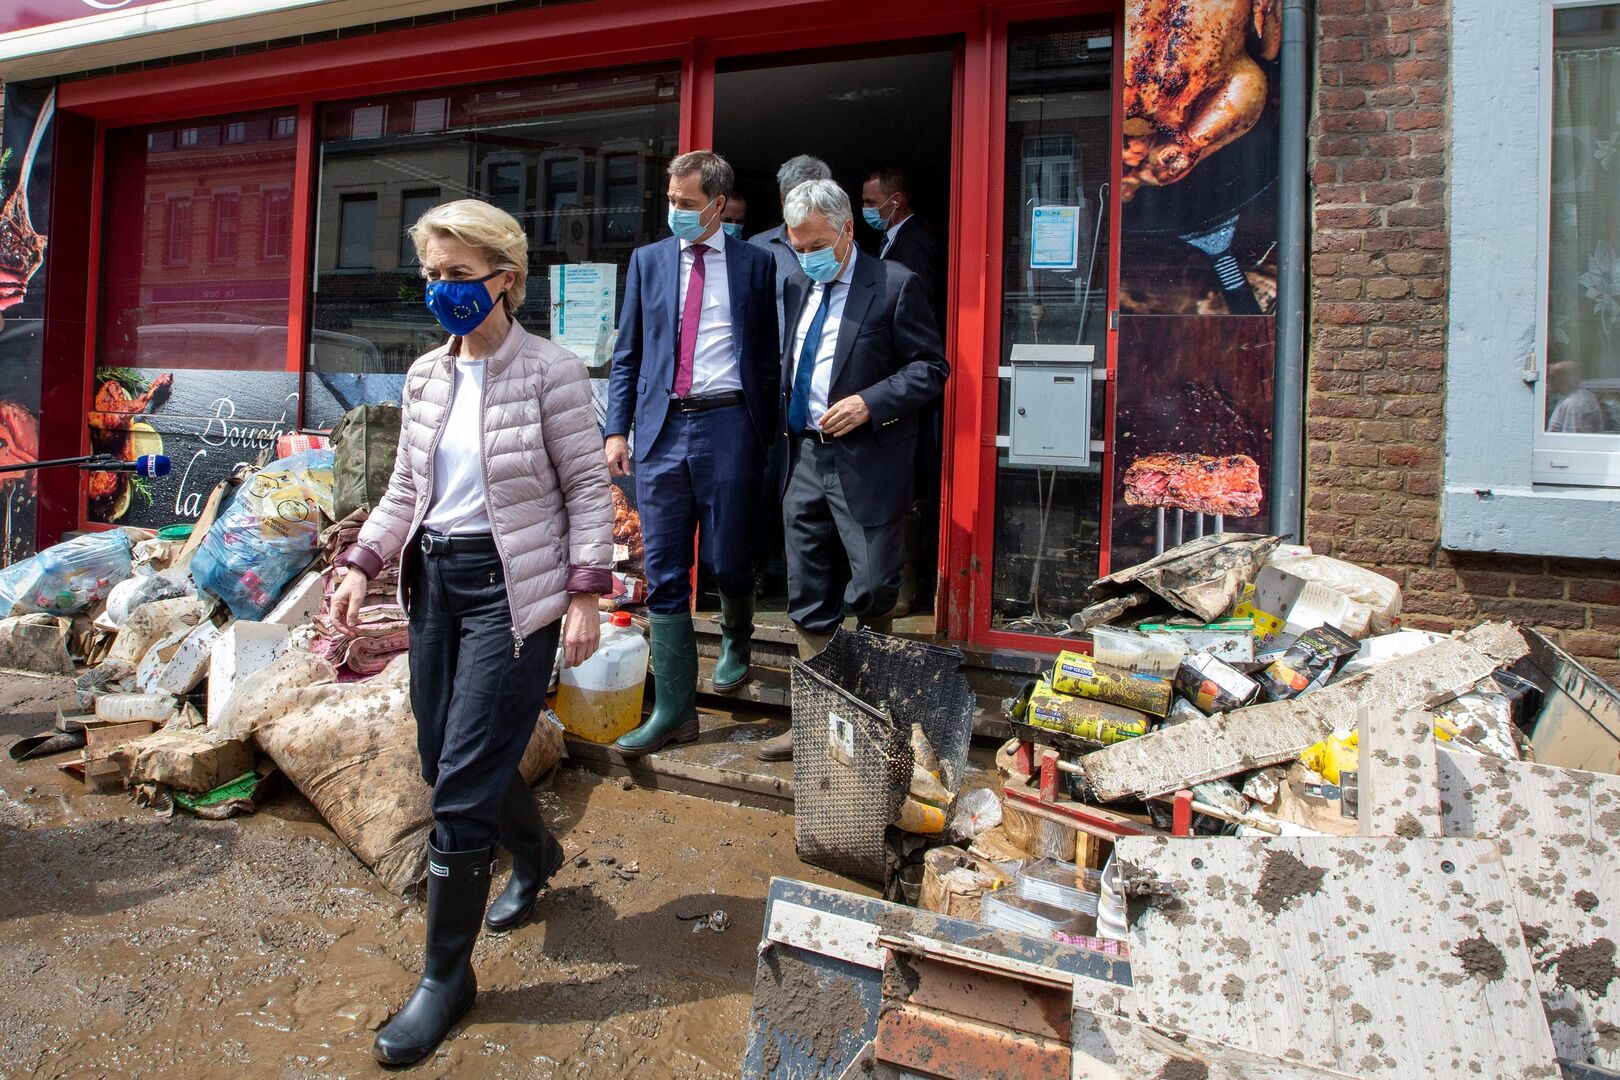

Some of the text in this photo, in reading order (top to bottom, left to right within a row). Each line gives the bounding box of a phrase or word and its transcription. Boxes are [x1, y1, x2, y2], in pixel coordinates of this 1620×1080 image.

[195, 392, 299, 449] Bouch
[175, 449, 207, 517] la
[267, 515, 290, 532] CARTONS
[1062, 664, 1093, 675] TOP GLOVE
